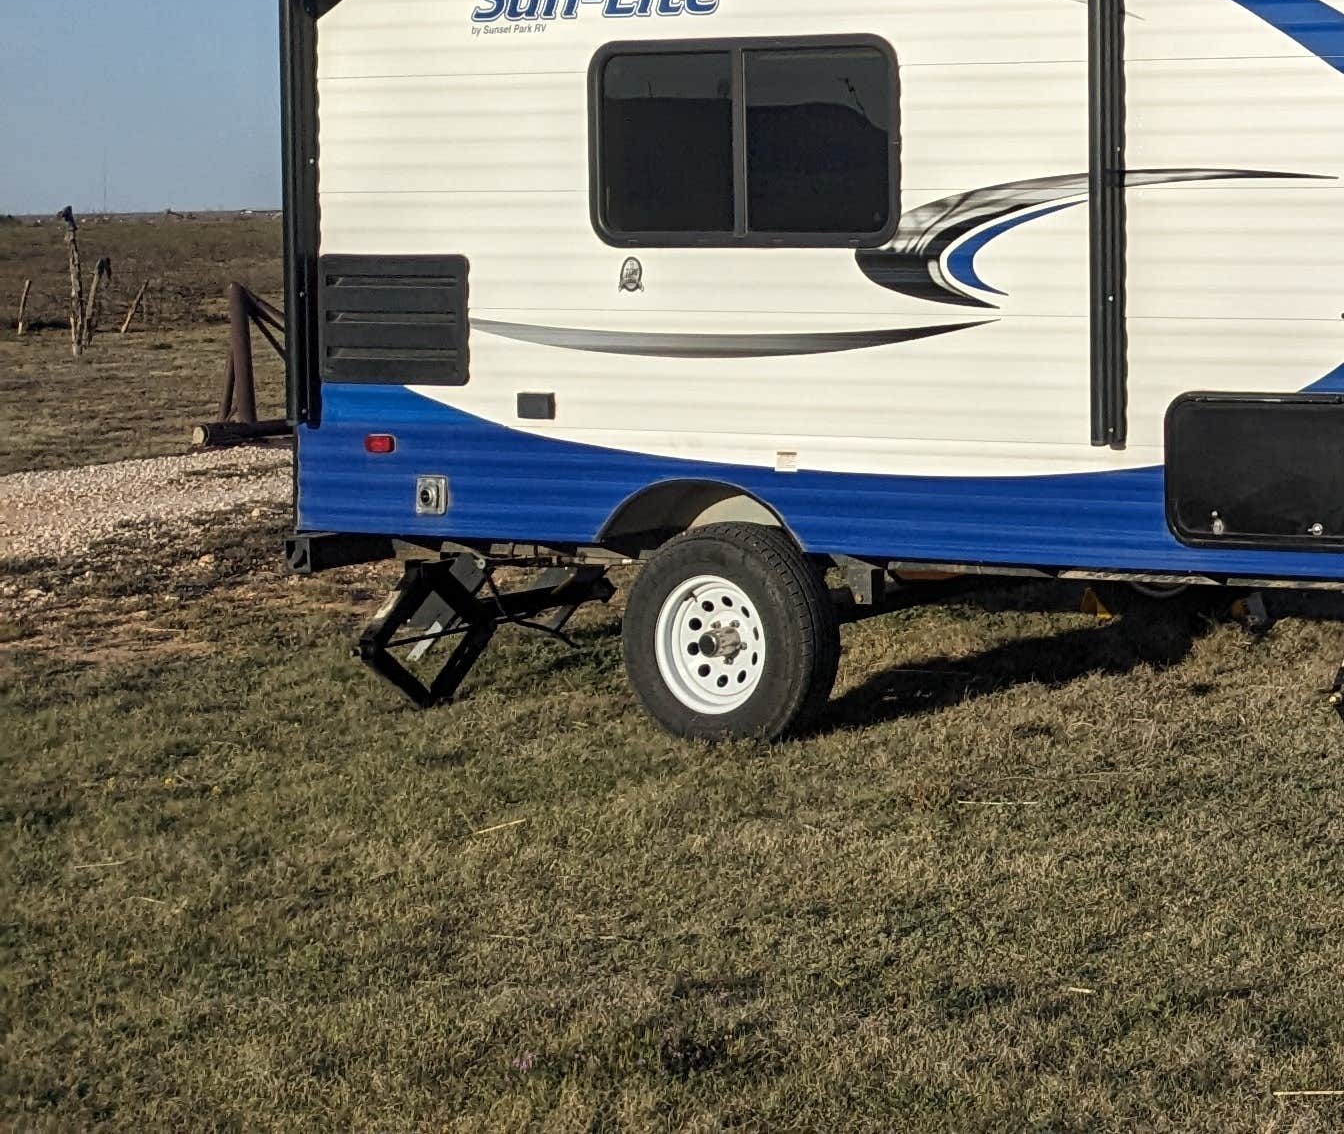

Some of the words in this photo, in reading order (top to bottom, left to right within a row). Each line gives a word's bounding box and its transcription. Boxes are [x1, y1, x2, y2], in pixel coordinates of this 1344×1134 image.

[471, 26, 481, 37] by
[483, 24, 512, 34] Sunset
[513, 24, 532, 33] Park
[534, 23, 547, 33] RV
